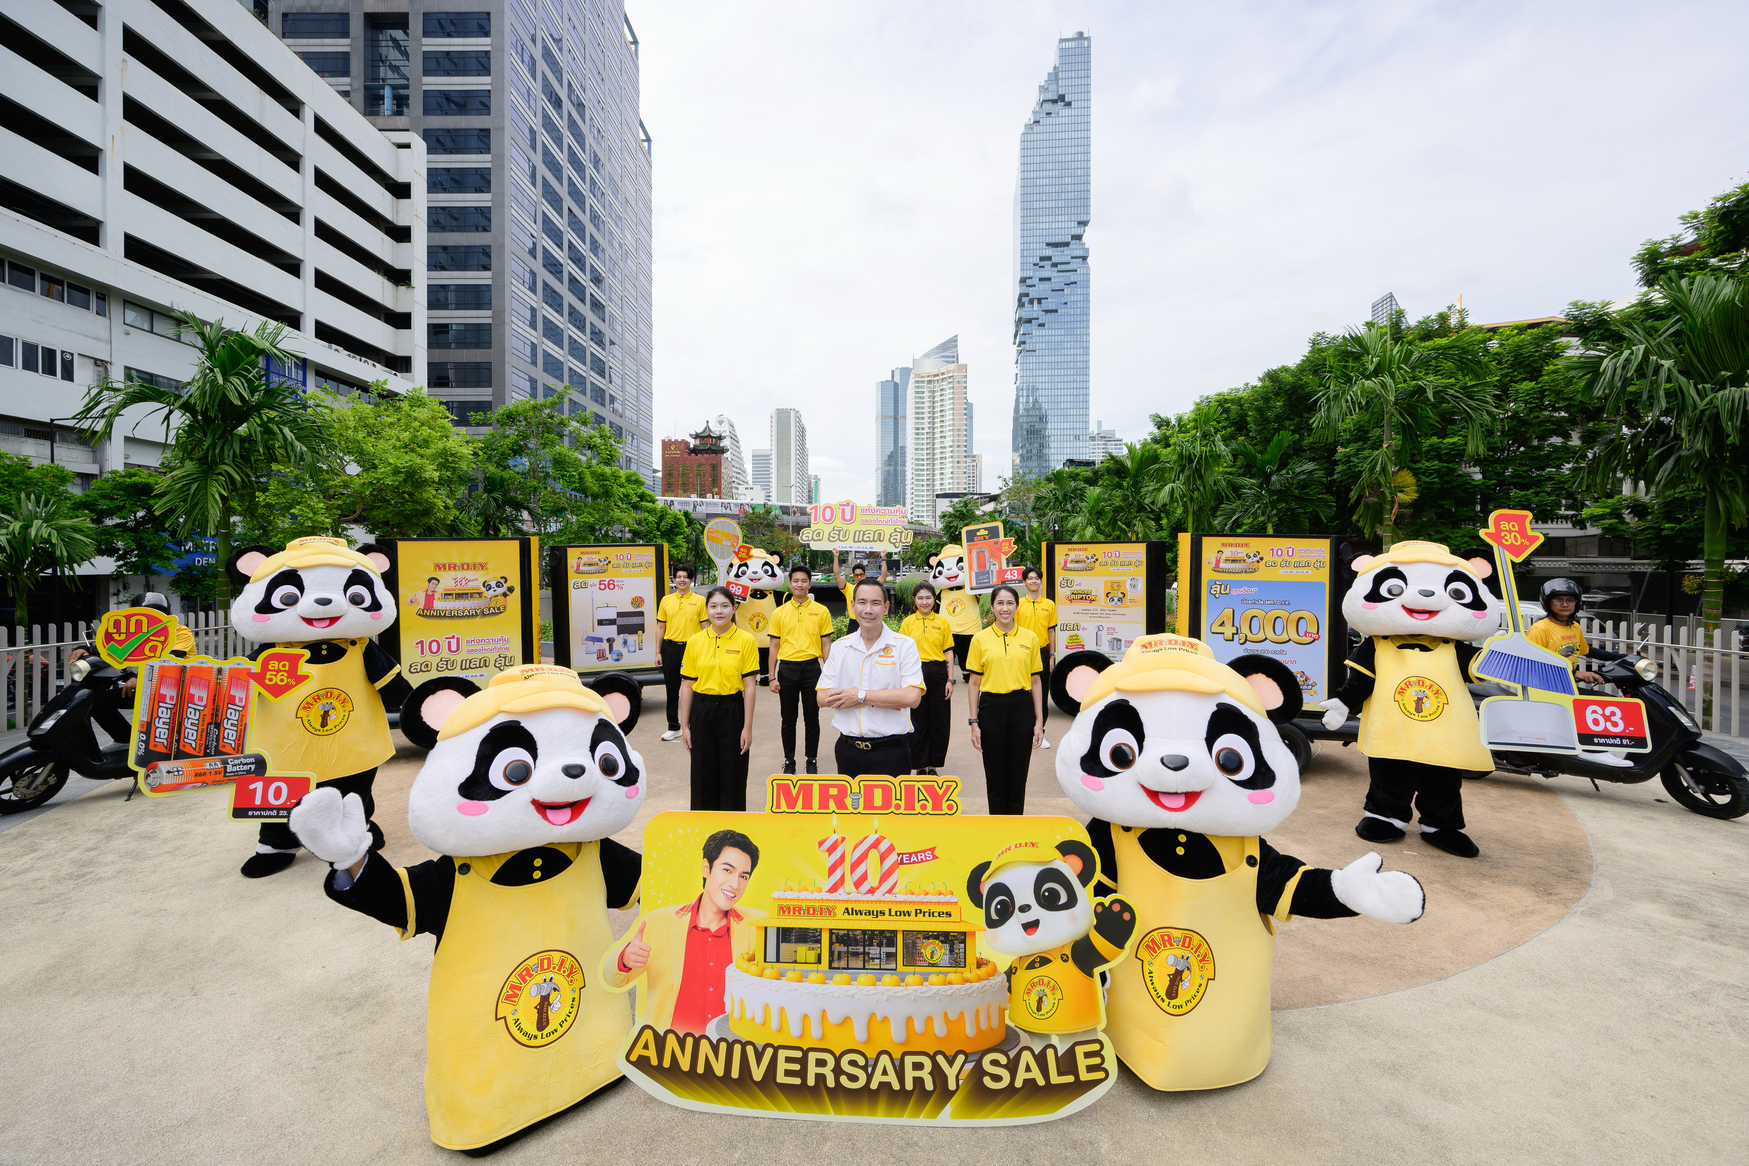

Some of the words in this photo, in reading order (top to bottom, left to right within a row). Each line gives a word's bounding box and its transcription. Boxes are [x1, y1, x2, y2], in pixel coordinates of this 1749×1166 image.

[808, 504, 836, 524] 10
[838, 501, 856, 523] ปี
[1500, 521, 1518, 531] ลด
[801, 529, 824, 542] ลด
[828, 526, 850, 542] รับ
[853, 529, 885, 543] แลก
[889, 527, 912, 548] ลุ้น
[1501, 532, 1529, 545] 30%
[1102, 550, 1112, 558] 10
[1269, 548, 1284, 558] 10
[452, 576, 470, 588] 10
[573, 580, 588, 589] ลด
[1060, 577, 1074, 588] รับ
[1210, 581, 1230, 599] ลุ้น
[417, 608, 481, 617] ANNIVERSARY
[484, 605, 506, 615] SALE
[108, 615, 148, 640] ถูก
[1060, 623, 1081, 631] แลก
[1210, 608, 1320, 645] 4,000
[414, 639, 441, 656] 10
[444, 634, 461, 654] ปี
[268, 660, 289, 670] ลด
[409, 661, 432, 674] ลด
[436, 658, 457, 672] รับ
[460, 656, 490, 671] แลก
[494, 654, 515, 671] ลุ้น
[265, 672, 296, 685] 56%
[154, 676, 179, 749] Player
[184, 676, 210, 751] Player
[223, 677, 248, 751] Player
[1586, 705, 1634, 733] 63.-
[226, 763, 256, 772] Battery
[818, 834, 900, 895] 10
[898, 851, 933, 863] YEARS
[842, 907, 886, 919] Always
[888, 908, 912, 917] Low
[914, 909, 952, 918] Prices
[1167, 1001, 1183, 1009] Low
[1185, 983, 1202, 1006] Prices
[512, 1017, 538, 1040] Always
[540, 1027, 558, 1039] Low
[559, 997, 576, 1028] Prices
[629, 1028, 966, 1091] ANNIVERSARY
[982, 1043, 1106, 1090] SALE
